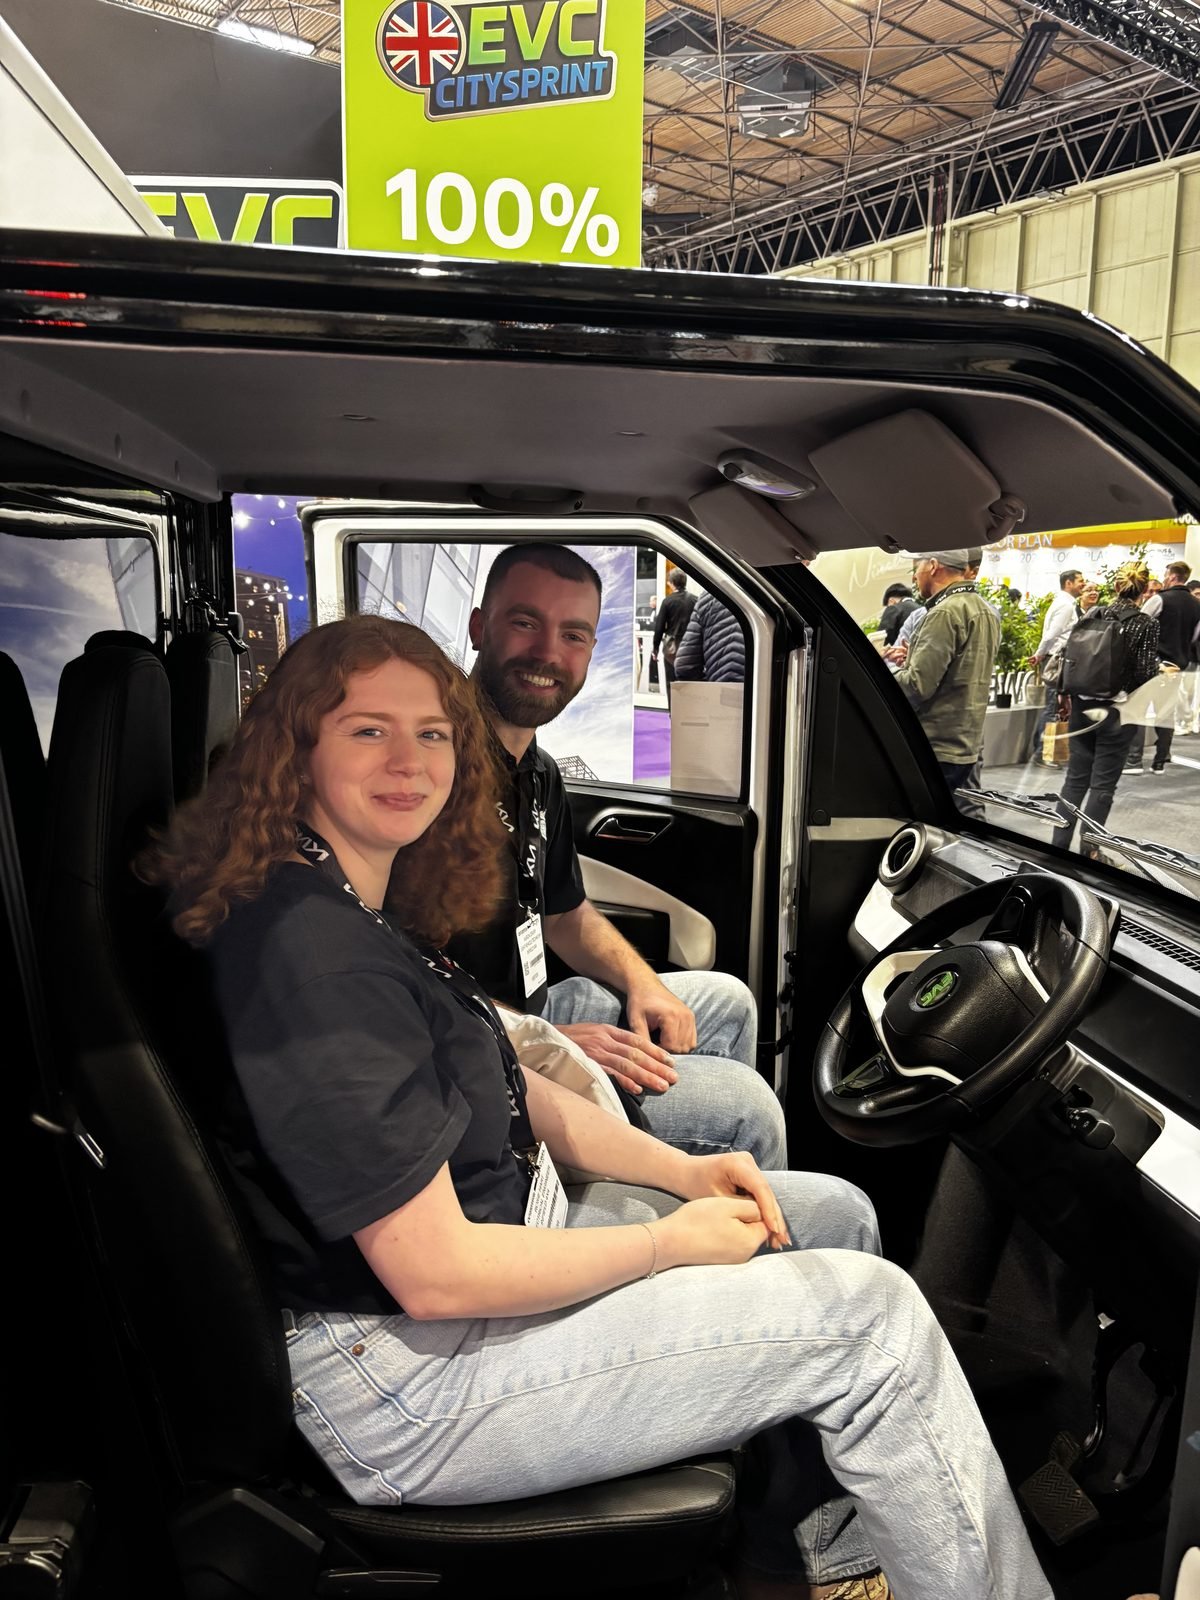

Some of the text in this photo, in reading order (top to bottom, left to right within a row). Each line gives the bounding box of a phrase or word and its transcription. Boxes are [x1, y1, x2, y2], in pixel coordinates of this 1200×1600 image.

[467, 0, 600, 65] EVC
[436, 61, 609, 109] CITYSPRINT
[385, 168, 620, 258] 100%
[1018, 533, 1053, 548] PLAN
